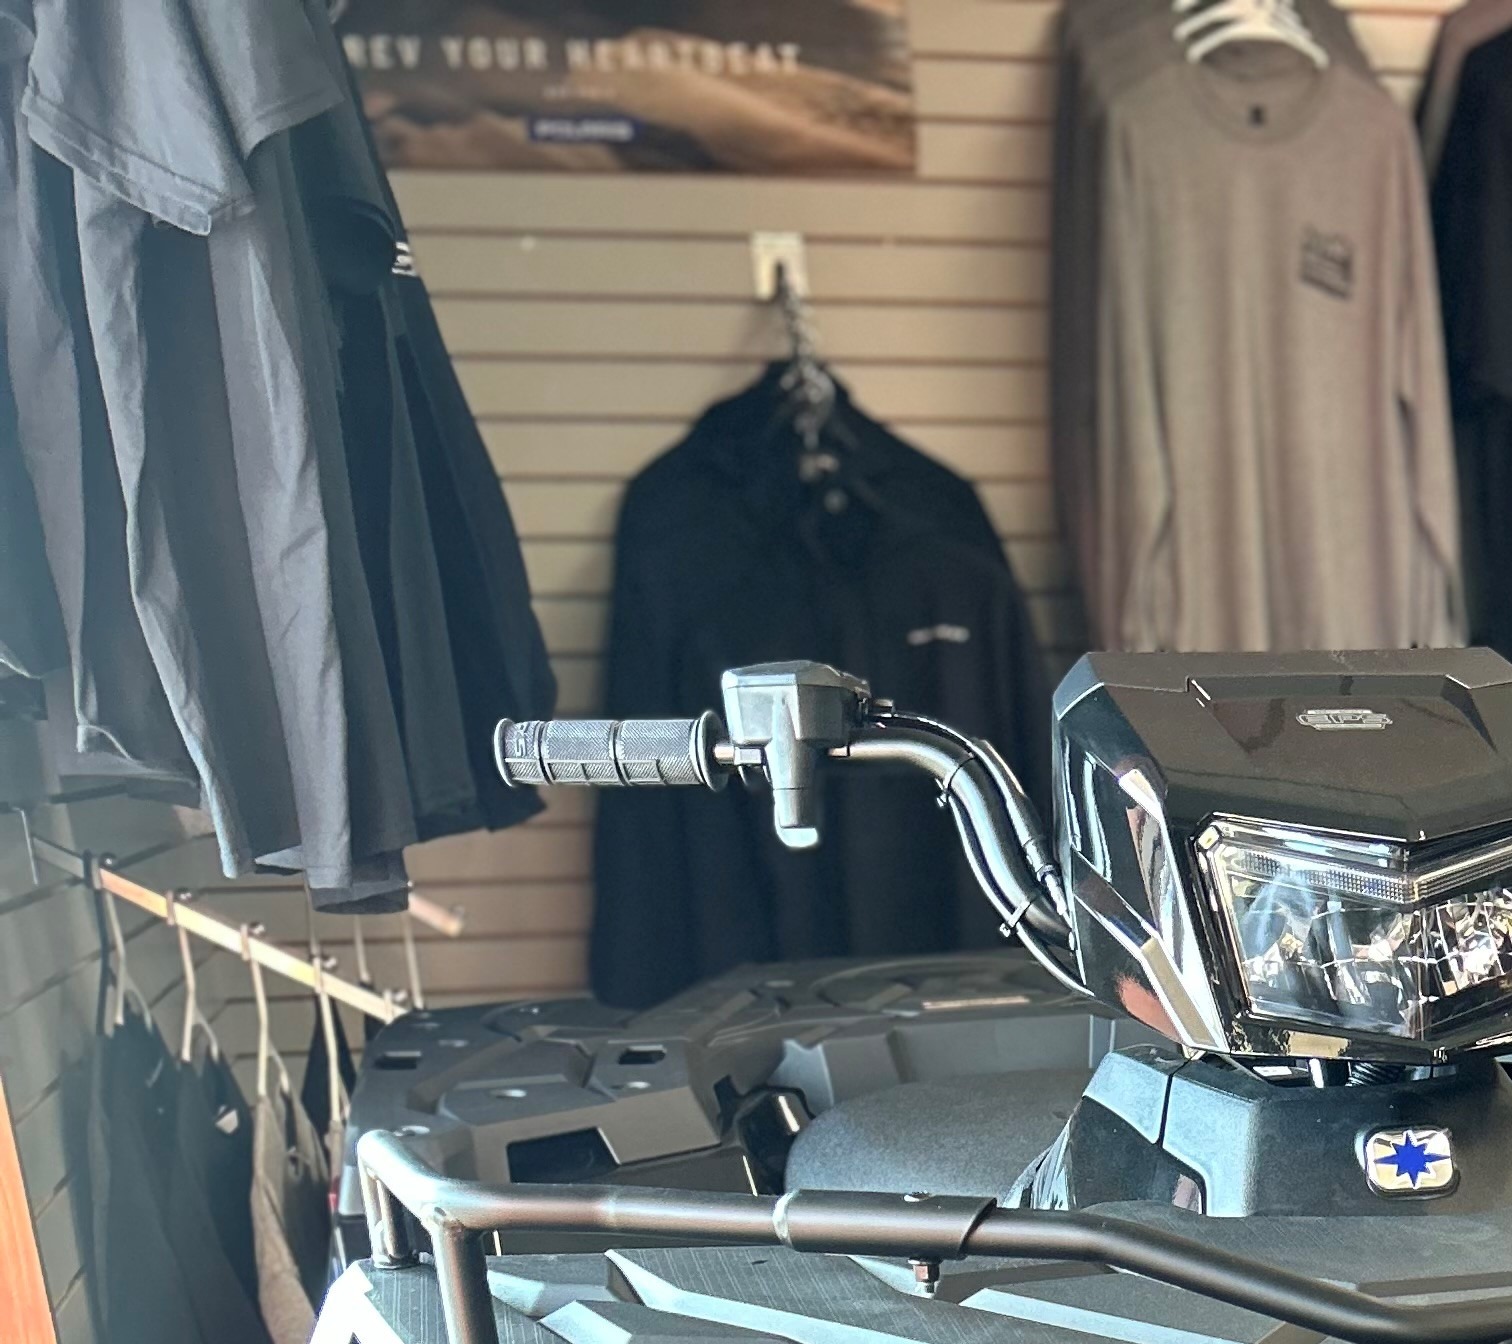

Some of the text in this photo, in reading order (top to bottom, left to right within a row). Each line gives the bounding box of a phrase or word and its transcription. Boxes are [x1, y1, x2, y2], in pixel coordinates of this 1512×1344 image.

[343, 33, 801, 75] REV YOUR HEARTBEAT
